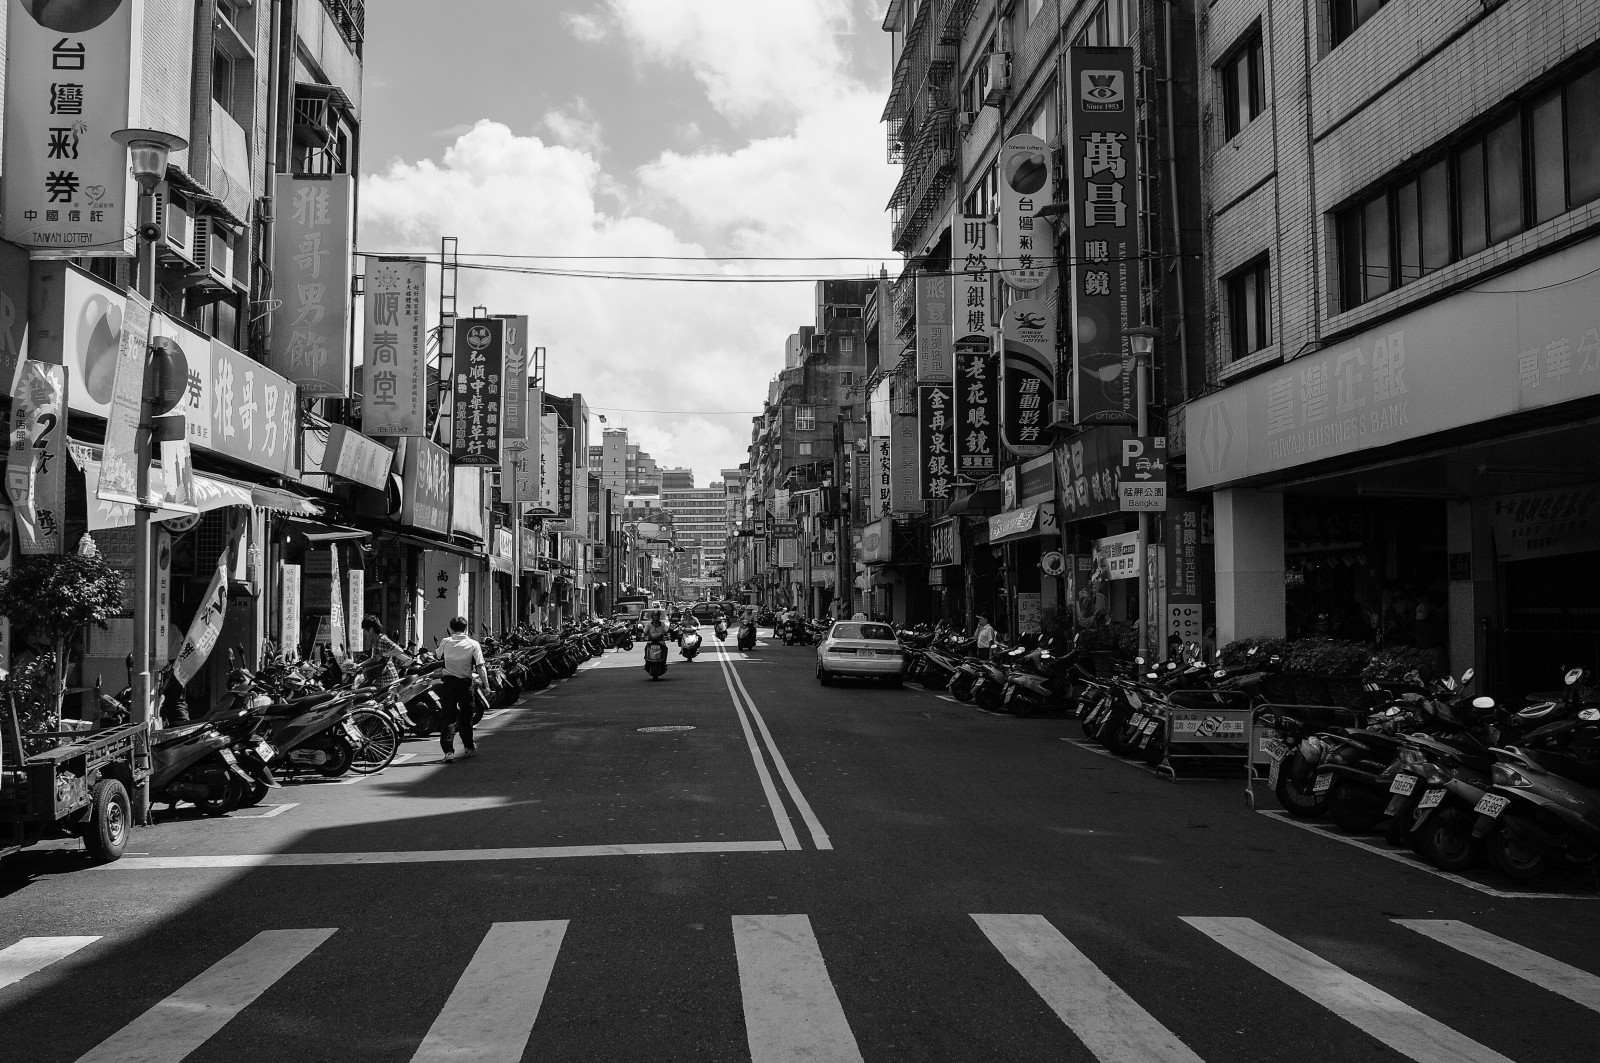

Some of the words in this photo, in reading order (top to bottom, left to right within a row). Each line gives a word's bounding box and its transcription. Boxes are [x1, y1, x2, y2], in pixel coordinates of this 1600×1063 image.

[46, 38, 86, 203] 台灣彩券
[1086, 102, 1103, 110] Since
[1104, 102, 1119, 110] 1953
[24, 209, 104, 222] 中國信託
[33, 232, 62, 243] TAIWAN
[63, 232, 93, 243] LOTTERY
[1019, 197, 1034, 269] 台灣彩券
[284, 186, 331, 377] 雅哥男飾
[963, 220, 988, 333] 明瑩銀樓
[372, 291, 401, 406] 順春堂
[1119, 295, 1130, 359] PROFESSONAL
[964, 355, 990, 454] 老花眼鏡
[1018, 378, 1041, 441] 運動彩券
[1266, 329, 1409, 436] 臺灣企銀
[927, 387, 952, 499] 金再泉銀樓
[1122, 439, 1144, 466] P
[1267, 438, 1306, 461] TAIWAN
[1308, 415, 1367, 449] BUSINESS
[1370, 400, 1409, 435] BANK
[879, 441, 891, 518] 香家自助餐
[1123, 487, 1164, 497] 艋舺公園
[1128, 499, 1158, 508] Bangka
[1182, 511, 1197, 596] 視康散光日拋
